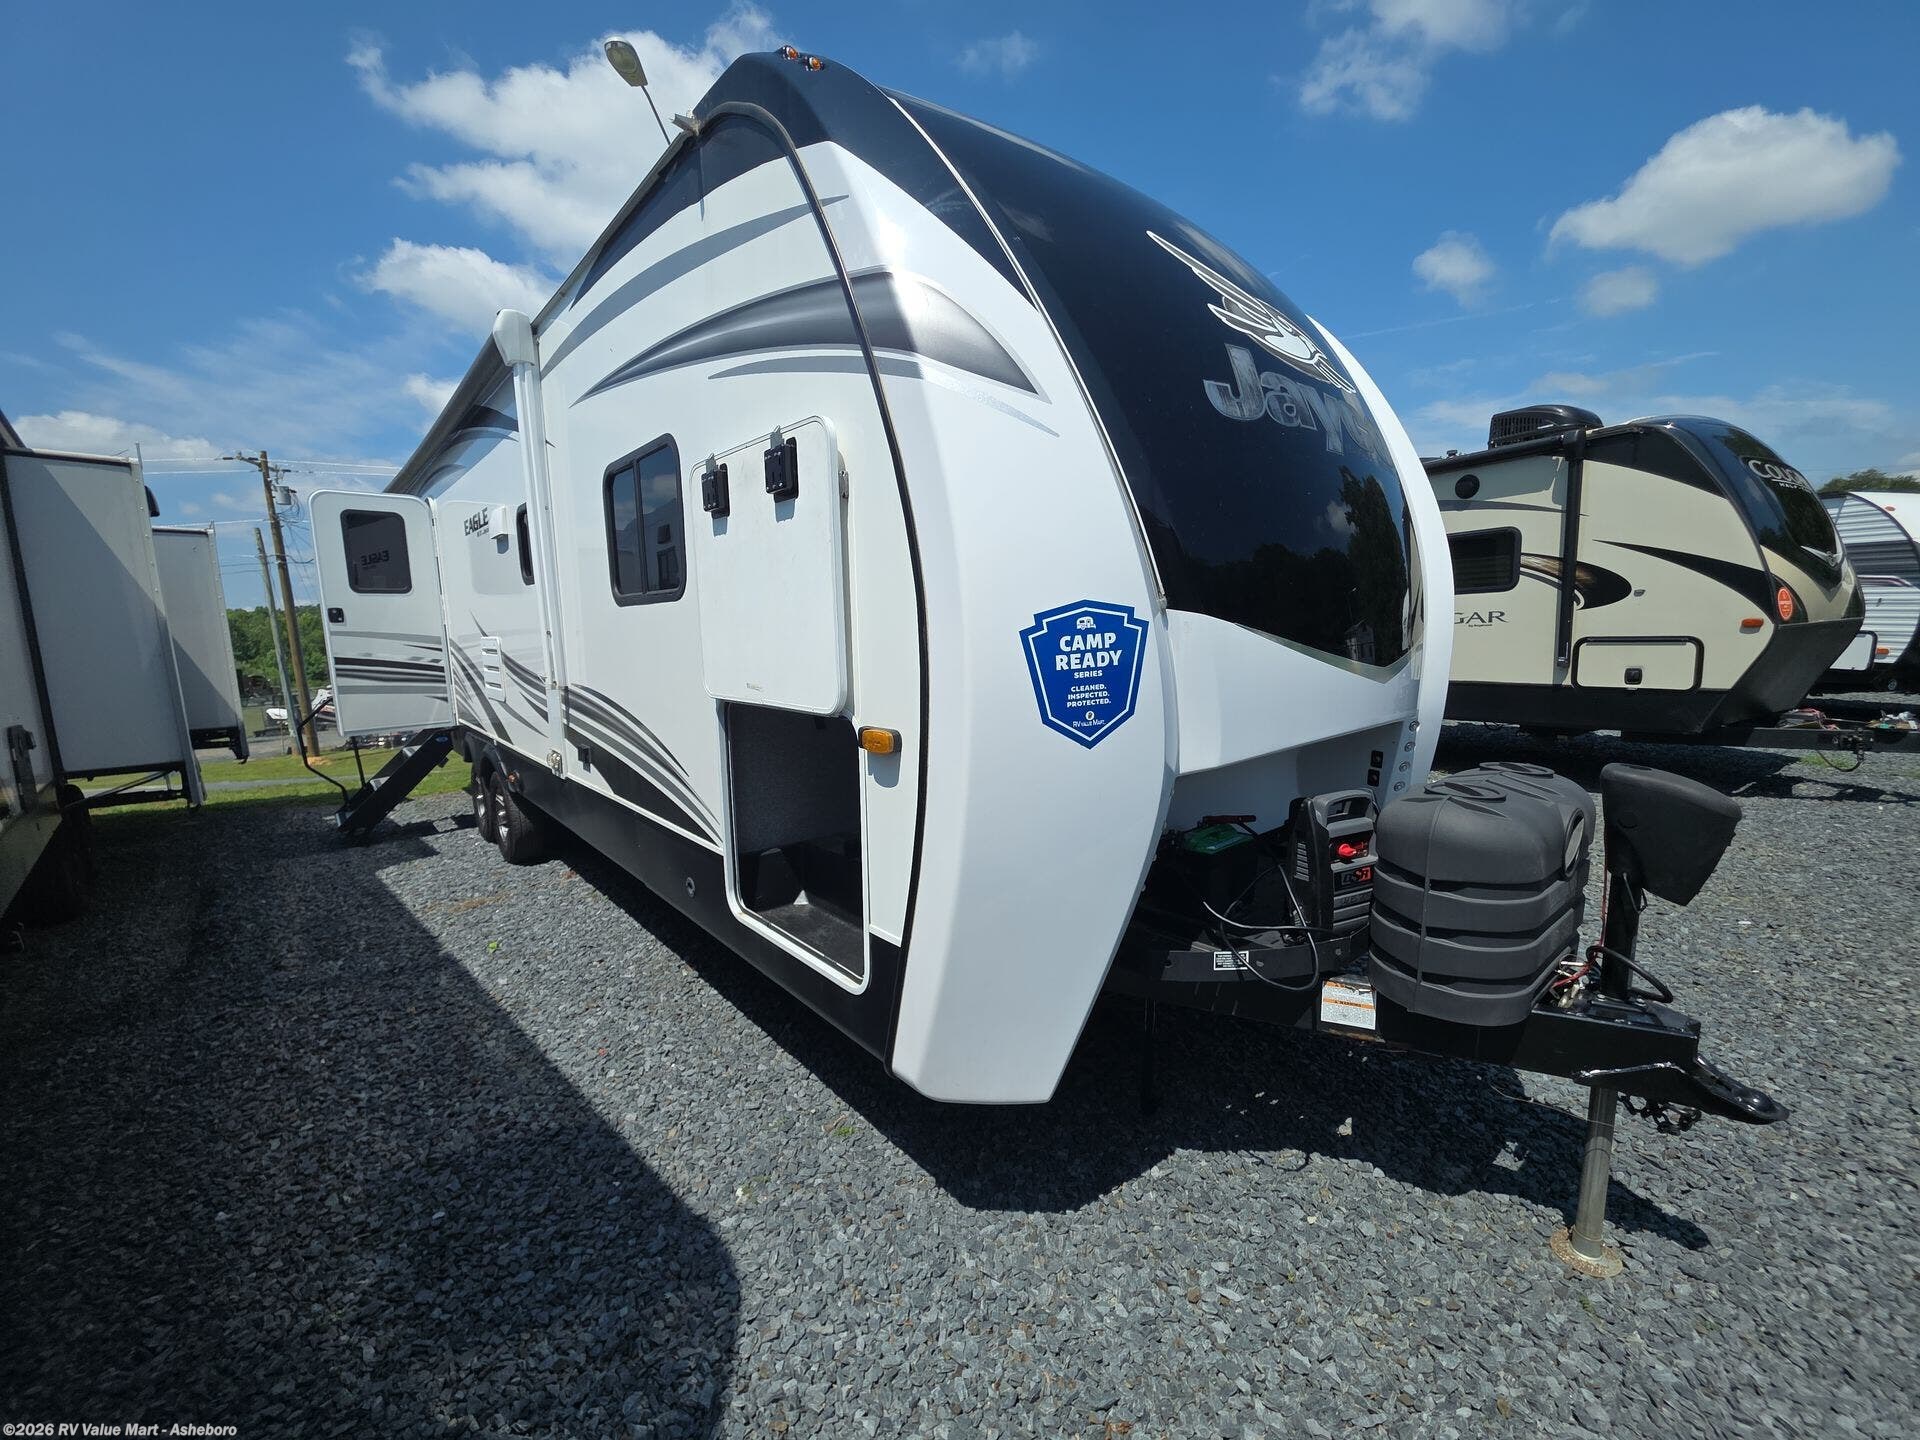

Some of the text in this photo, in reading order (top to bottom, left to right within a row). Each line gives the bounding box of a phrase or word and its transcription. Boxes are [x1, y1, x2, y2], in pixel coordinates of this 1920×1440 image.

[463, 506, 489, 537] EAGLE
[1059, 632, 1117, 652] CAMP
[1055, 650, 1123, 671] READY
[1073, 670, 1103, 679] SERIES
[1070, 683, 1107, 692] CLEANED.
[1067, 691, 1110, 700] INSPECTED.
[1066, 698, 1112, 708] PROTECTED.
